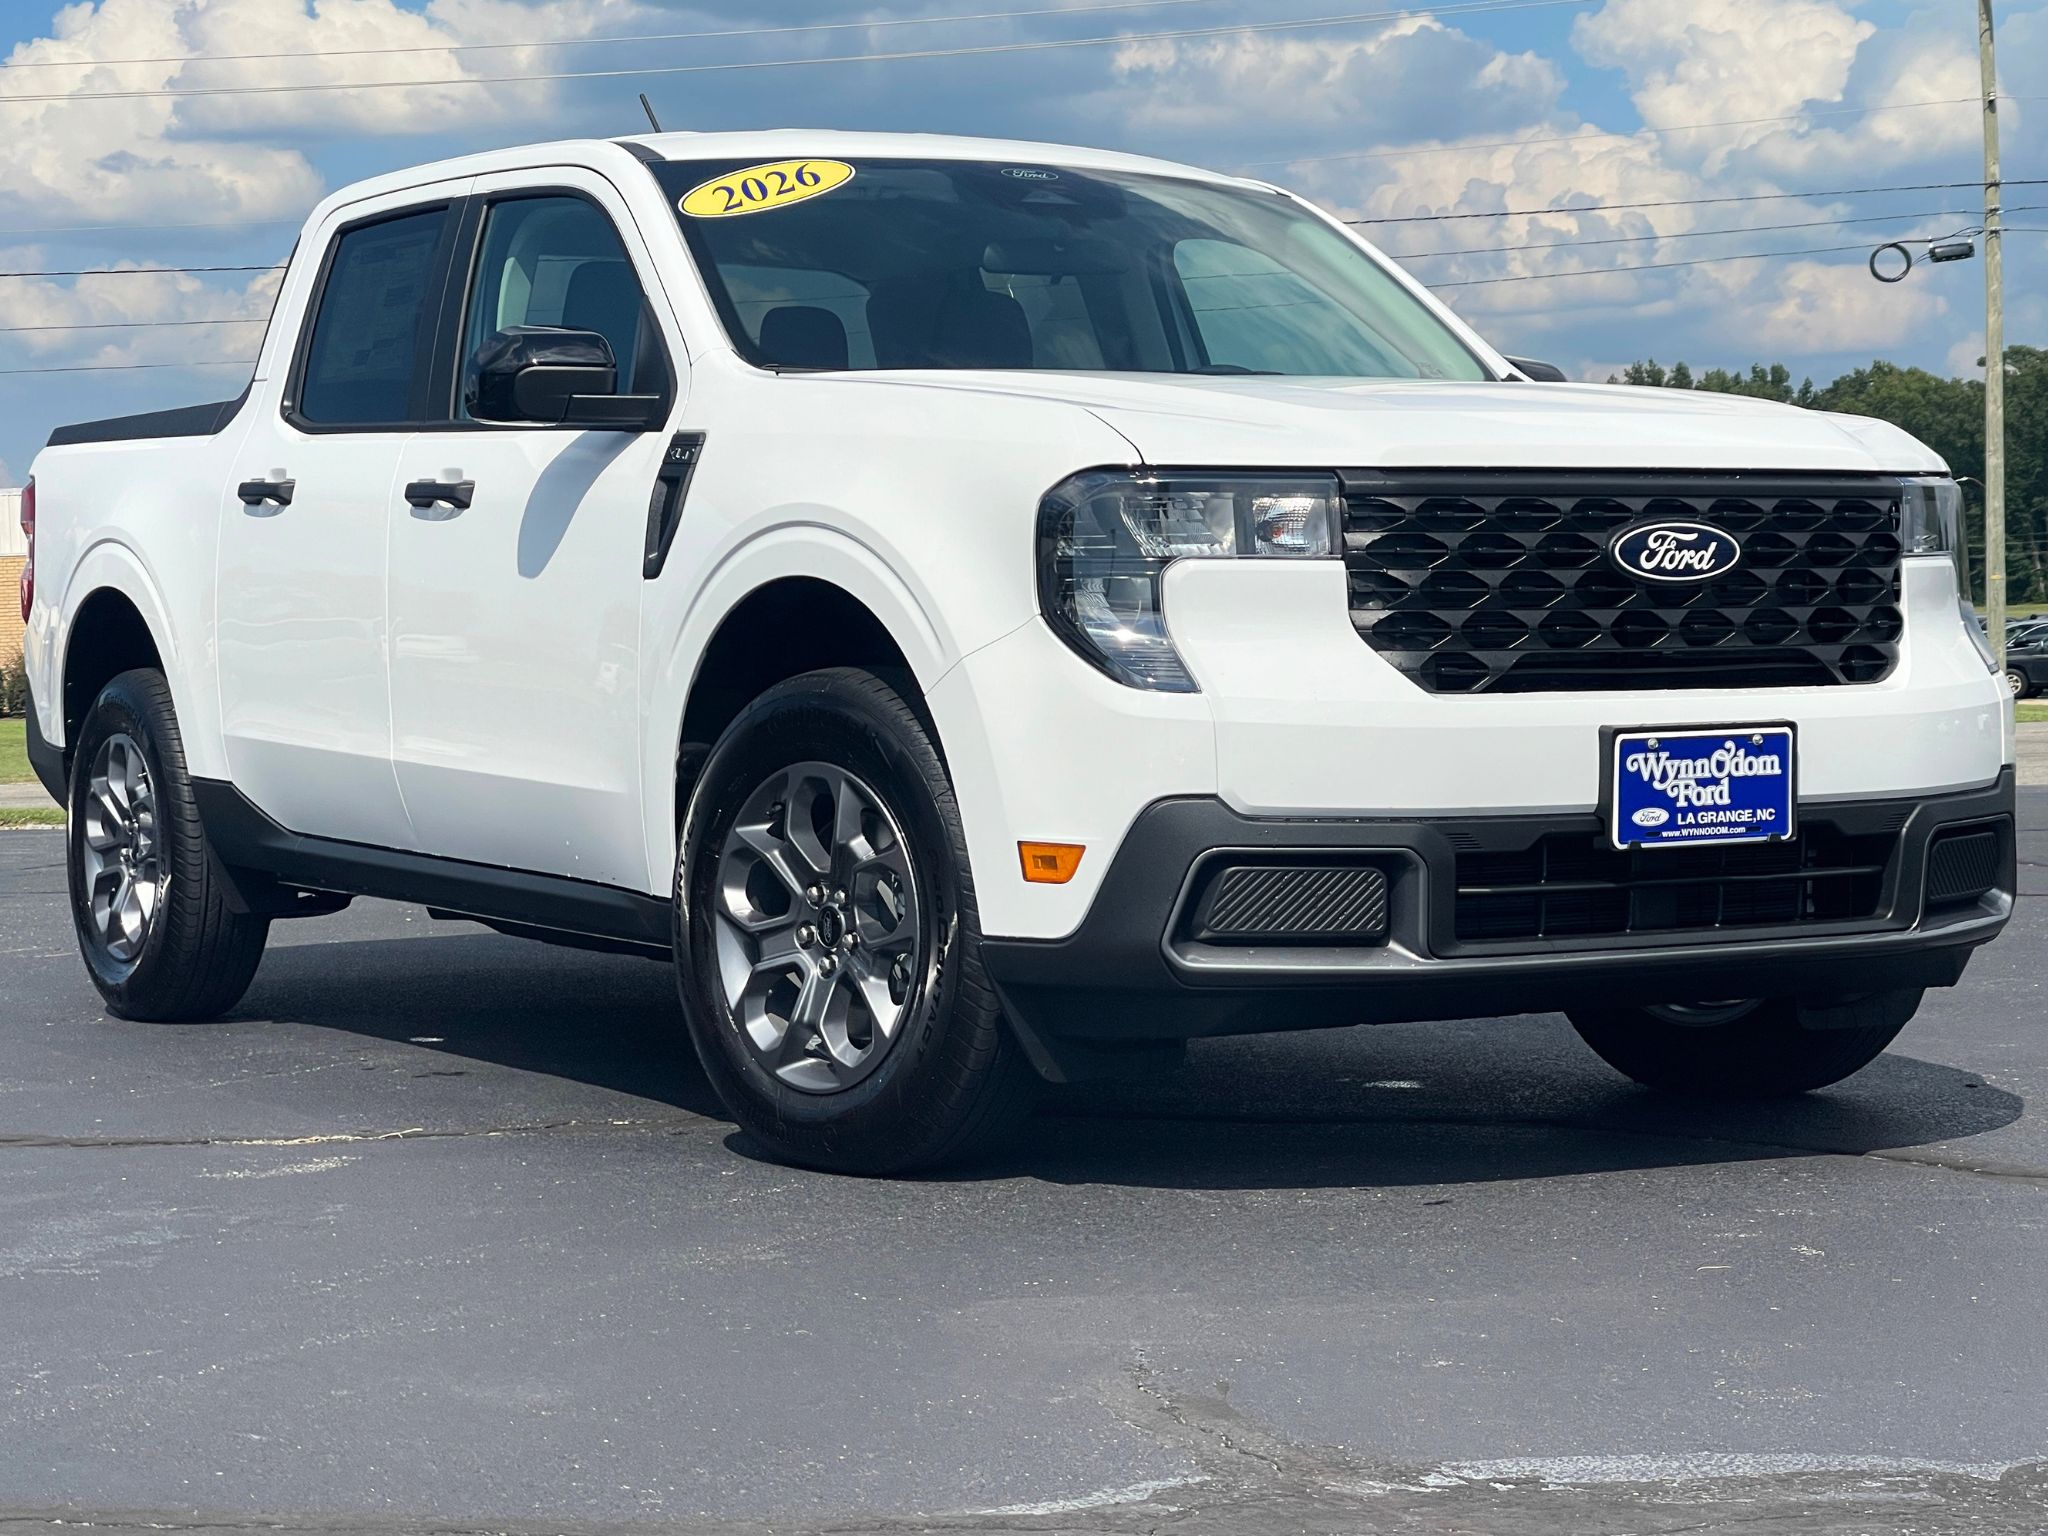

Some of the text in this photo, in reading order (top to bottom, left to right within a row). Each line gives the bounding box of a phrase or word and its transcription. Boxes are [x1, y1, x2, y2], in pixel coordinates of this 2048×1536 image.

[1012, 168, 1048, 179] Ford
[712, 162, 821, 212] 2026
[1640, 530, 1718, 570] Ford
[1666, 777, 1731, 807] Ford
[1639, 811, 1662, 822] Ford
[1677, 813, 1695, 825] LA
[1661, 826, 1746, 838] www.WYNNODOM.com
